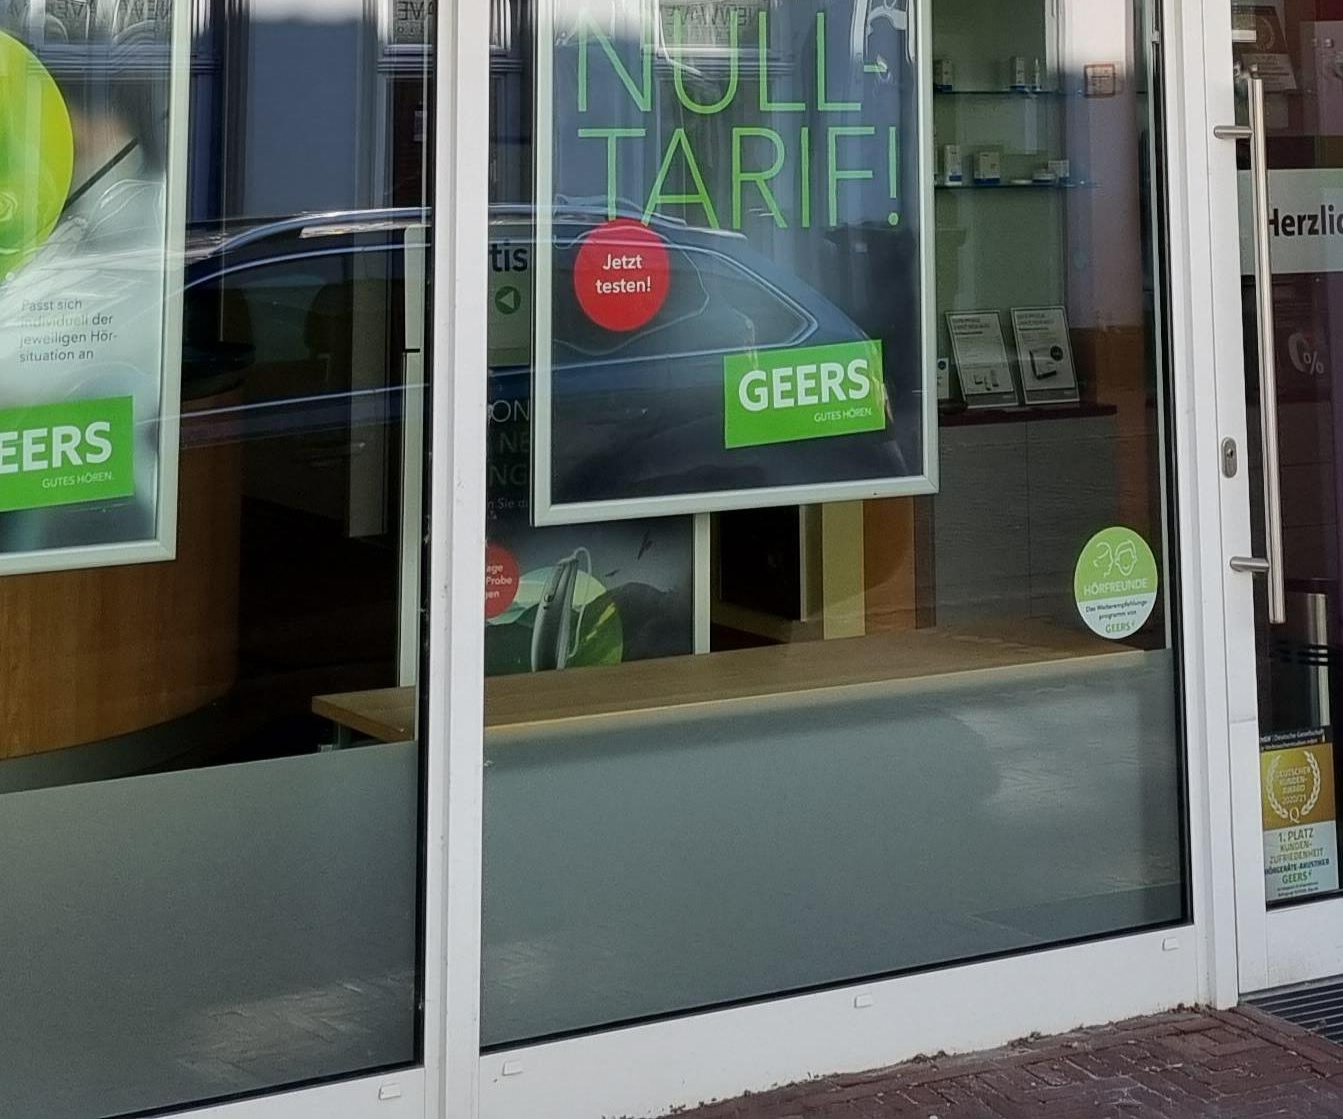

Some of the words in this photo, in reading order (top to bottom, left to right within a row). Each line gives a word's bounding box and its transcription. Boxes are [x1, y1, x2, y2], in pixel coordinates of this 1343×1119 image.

[578, 8, 887, 114] NULL-
[578, 127, 899, 229] TARIF!
[603, 253, 643, 271] Jetzt
[595, 276, 651, 294] testen!
[21, 299, 54, 312] Passt
[57, 299, 82, 311] sich
[20, 315, 88, 329] individuell
[92, 314, 114, 326] der
[19, 333, 87, 348] jeweiligen
[90, 331, 118, 343] Hör-
[19, 349, 74, 363] situation
[78, 350, 94, 360] an
[739, 359, 870, 411] GEERS
[814, 411, 841, 422] GUTES
[42, 475, 75, 489] GUTES
[1106, 623, 1131, 633] GEERS
[1288, 828, 1314, 840] PLATZ
[1282, 873, 1307, 884] GEERS
